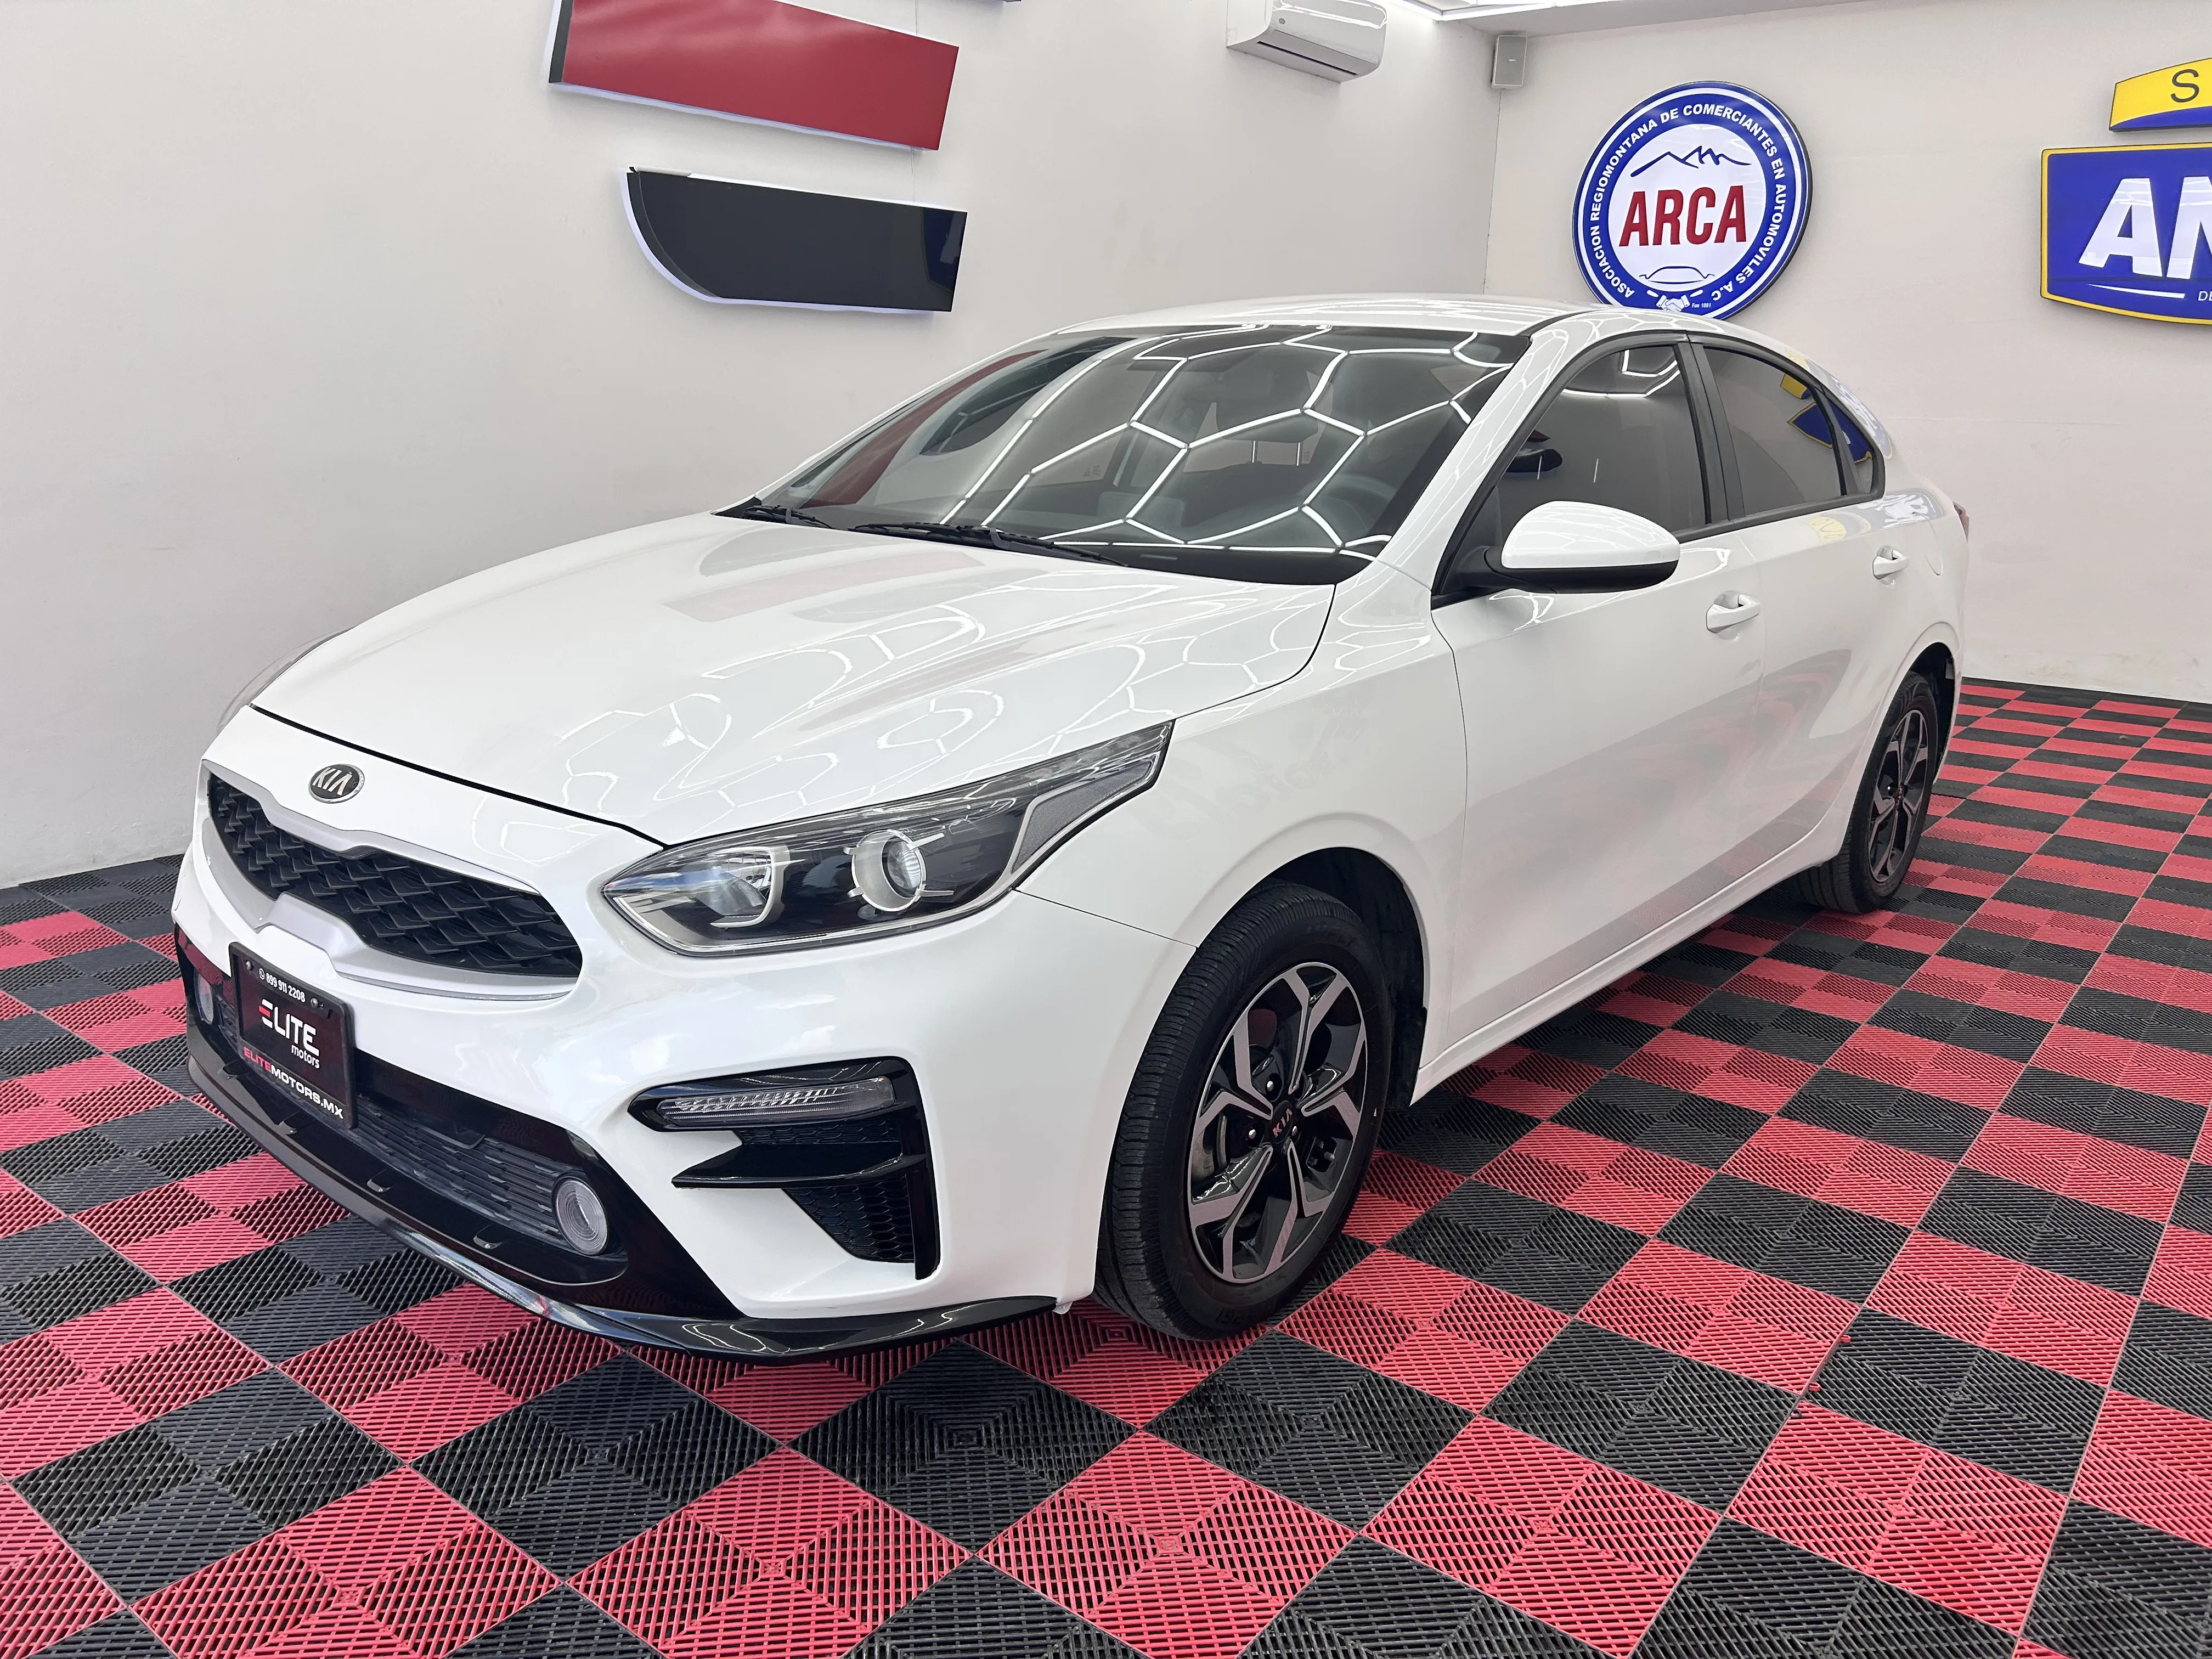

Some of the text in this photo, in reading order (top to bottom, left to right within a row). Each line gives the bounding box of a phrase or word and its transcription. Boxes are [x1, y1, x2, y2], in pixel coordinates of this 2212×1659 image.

[1660, 108, 1679, 123] DE
[1683, 103, 1778, 157] COMERCIANTES
[1590, 119, 1658, 221] REGIOMONTANA
[1770, 157, 1785, 180] EN
[1618, 185, 1747, 247] ARCA
[1736, 184, 1786, 284] AUTOMOVILES
[1590, 225, 1635, 298] ASOCIACION
[312, 767, 353, 797] KIA
[266, 972, 306, 1003] 899 911 2208
[258, 998, 319, 1057] ELITE
[244, 1047, 344, 1119] ELITEMOTORS.MX
[291, 1043, 320, 1069] motors
[1272, 1108, 1293, 1138] KIA
